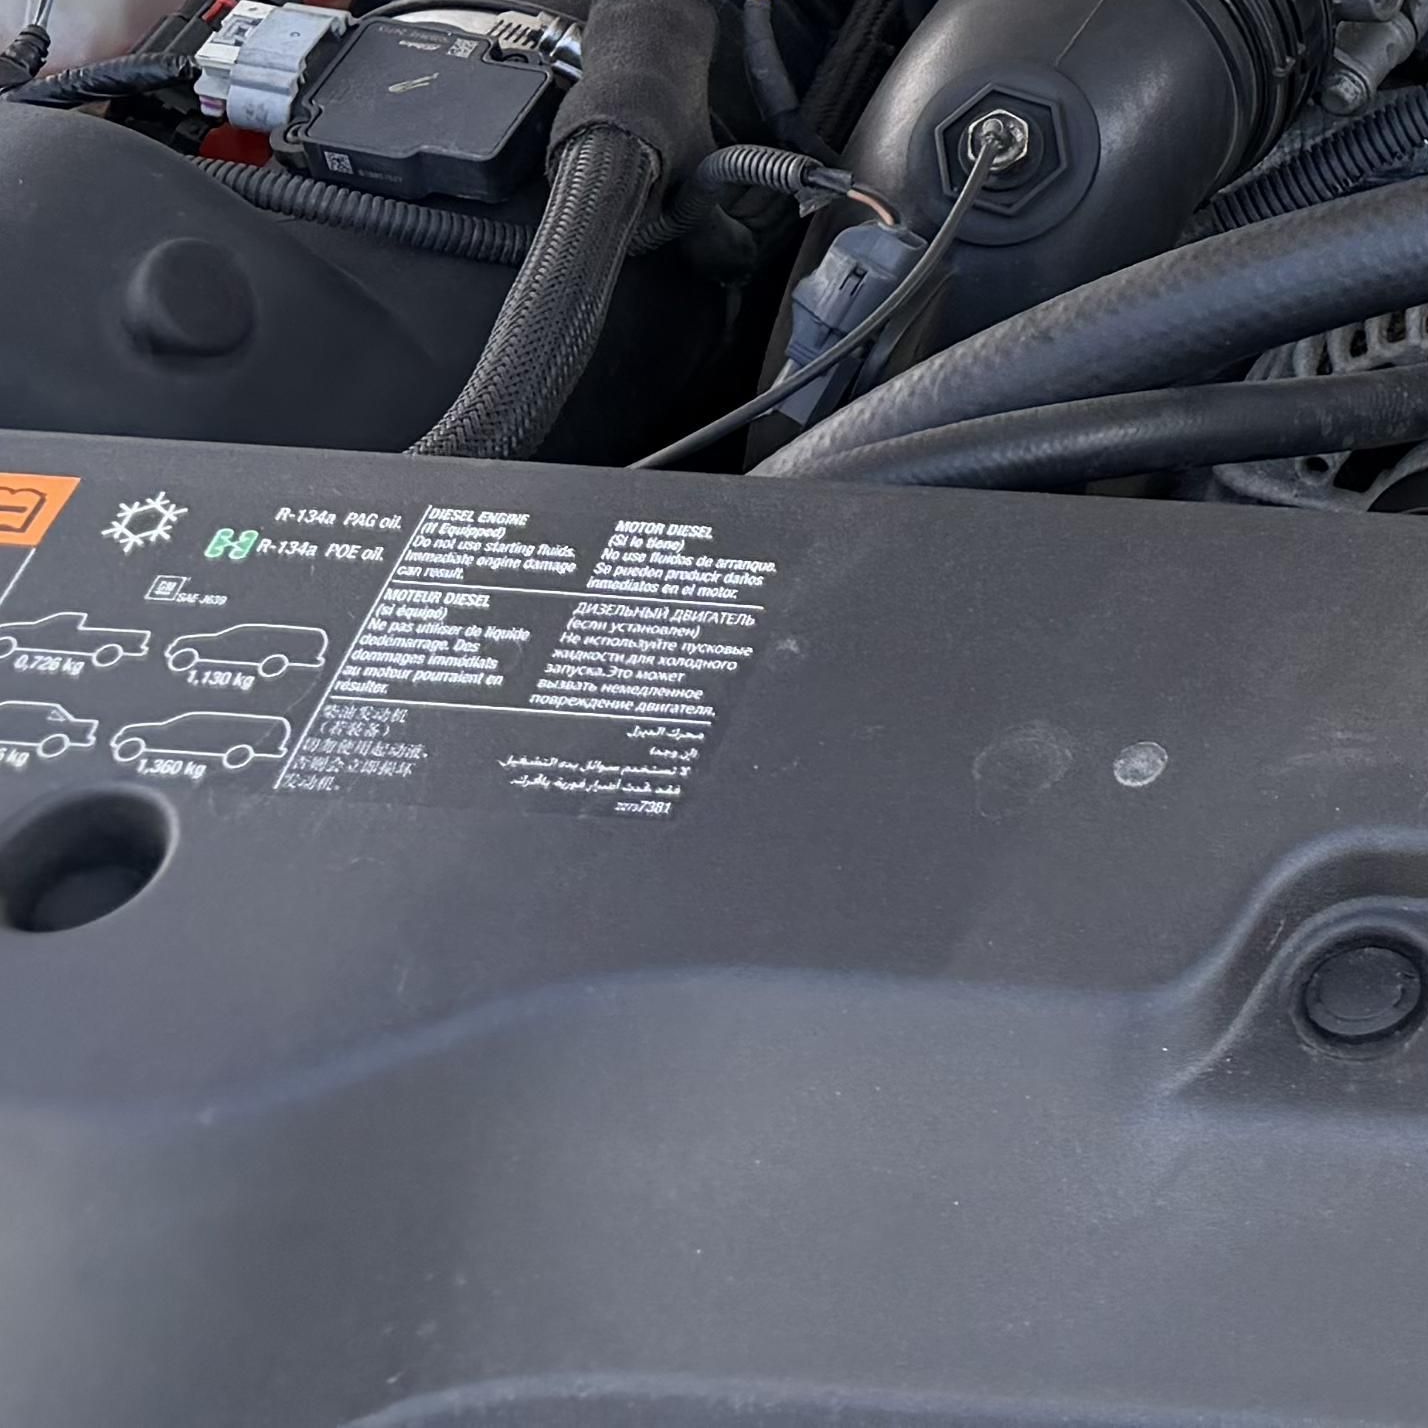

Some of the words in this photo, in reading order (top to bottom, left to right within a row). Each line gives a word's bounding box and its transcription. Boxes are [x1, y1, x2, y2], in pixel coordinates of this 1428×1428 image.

[274, 507, 337, 525] R-134a
[343, 511, 379, 528] PAG
[379, 514, 402, 530] oil.
[428, 507, 475, 523] DIESEL
[477, 510, 531, 527] ENGINE
[438, 522, 507, 540] Equipped)
[614, 519, 666, 535] MOTOR
[666, 523, 714, 540] DIESEL
[256, 538, 319, 556] R-134a
[324, 542, 361, 559] POE
[361, 546, 385, 561] oil.
[412, 535, 432, 548] Do
[433, 538, 457, 550] not
[458, 541, 483, 551] use
[484, 541, 536, 557] starting
[537, 543, 576, 558] fluids.
[630, 535, 644, 548] lo
[646, 538, 685, 553] tiene)
[404, 549, 475, 566] Immediate
[476, 555, 521, 570] engine
[523, 557, 577, 575] damage
[600, 547, 620, 562] No
[621, 551, 647, 563] use
[649, 552, 695, 567] fluidos
[695, 555, 714, 568] de
[715, 558, 778, 574] arranque.
[396, 565, 422, 577] can
[423, 567, 465, 580] result.
[593, 562, 613, 576] Se
[613, 564, 665, 579] pueden
[664, 567, 723, 584] producir
[176, 592, 200, 603] SAE
[383, 588, 443, 604] MOTEUR
[443, 591, 492, 608] DIESEL
[586, 576, 660, 593] inmediatos
[661, 583, 680, 595] en
[681, 583, 695, 596] el
[697, 585, 739, 600] motor.
[375, 603, 396, 618] (si
[572, 601, 668, 622] ДИЗЕЛЬНЫЙ
[669, 607, 756, 627] ДВИГАТЕЛЬ
[367, 617, 388, 631] Ne
[387, 621, 415, 634] pas
[415, 621, 464, 637] utiliser
[464, 624, 483, 638] de
[483, 625, 531, 642] liquide
[566, 615, 608, 631] (если
[608, 620, 701, 640] установлен)
[453, 638, 482, 653] Des
[559, 630, 581, 645] Не
[583, 635, 678, 653] используйте
[680, 641, 754, 658] пусковые
[13, 653, 61, 672] 0,726
[61, 656, 86, 676] kg
[351, 648, 426, 666] dommages
[552, 647, 625, 663] жидкости
[625, 653, 655, 666] для
[657, 655, 739, 672] холодного
[185, 669, 233, 687] 1,130
[233, 671, 256, 691] kg
[342, 664, 362, 677] au
[362, 665, 415, 681] moteur
[411, 669, 484, 686] pourraient
[485, 675, 504, 687] en
[635, 669, 686, 683] может
[334, 679, 389, 695] résulter.
[536, 678, 598, 693] вызвать
[600, 681, 704, 701] немедленное
[529, 692, 635, 712] повреждение
[635, 699, 716, 718] двигателя.
[6, 747, 30, 768] kg
[135, 758, 183, 775] 1,360
[183, 761, 207, 779] kg
